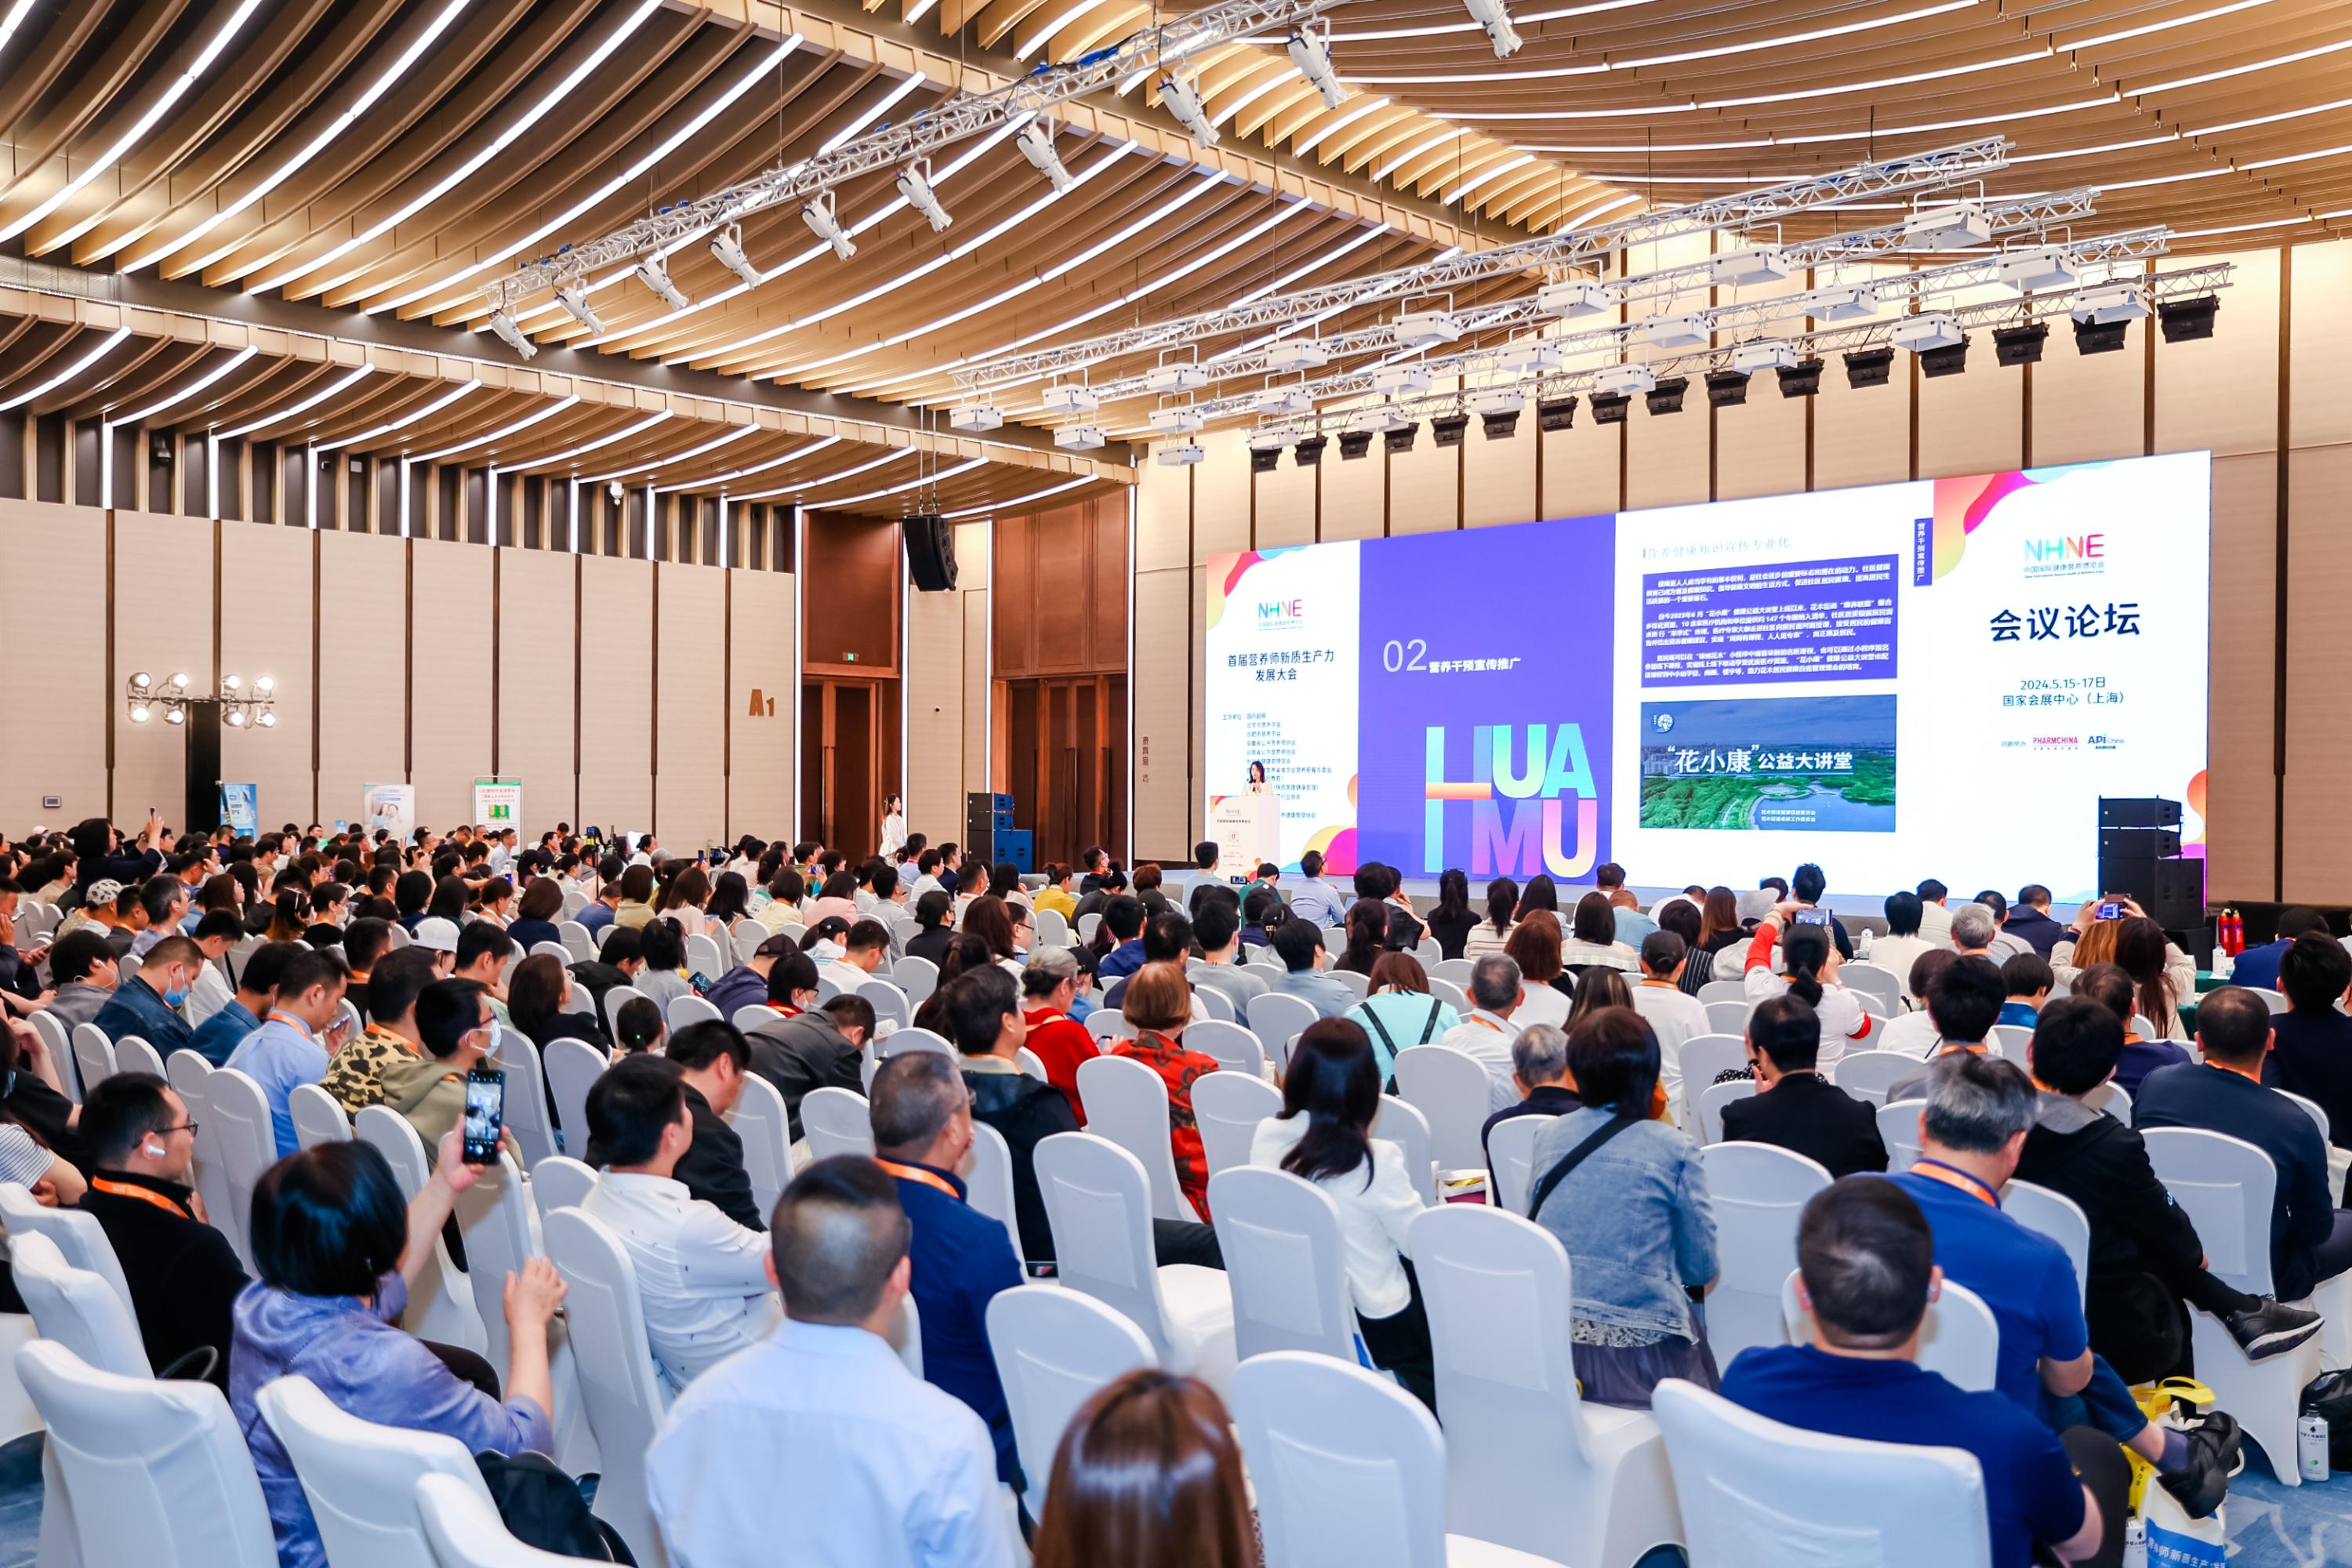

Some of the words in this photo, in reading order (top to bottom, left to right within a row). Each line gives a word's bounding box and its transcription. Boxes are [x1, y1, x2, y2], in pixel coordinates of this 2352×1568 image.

[2024, 534, 2105, 562] NHNE
[1258, 599, 1302, 619] NHNE
[1990, 603, 2140, 641] 会议论坛
[1228, 649, 1334, 667] 首届营养师新质生产力
[1383, 638, 1427, 673] 02
[1429, 657, 1521, 673] 营养干预宣传推广
[1255, 668, 1297, 681] 发展大会
[2020, 677, 2106, 691] 2024.5.15-17日
[749, 689, 775, 717] A1
[2002, 691, 2124, 706] 国家会展中心（上海）
[2033, 736, 2078, 745] PHARMCHINA
